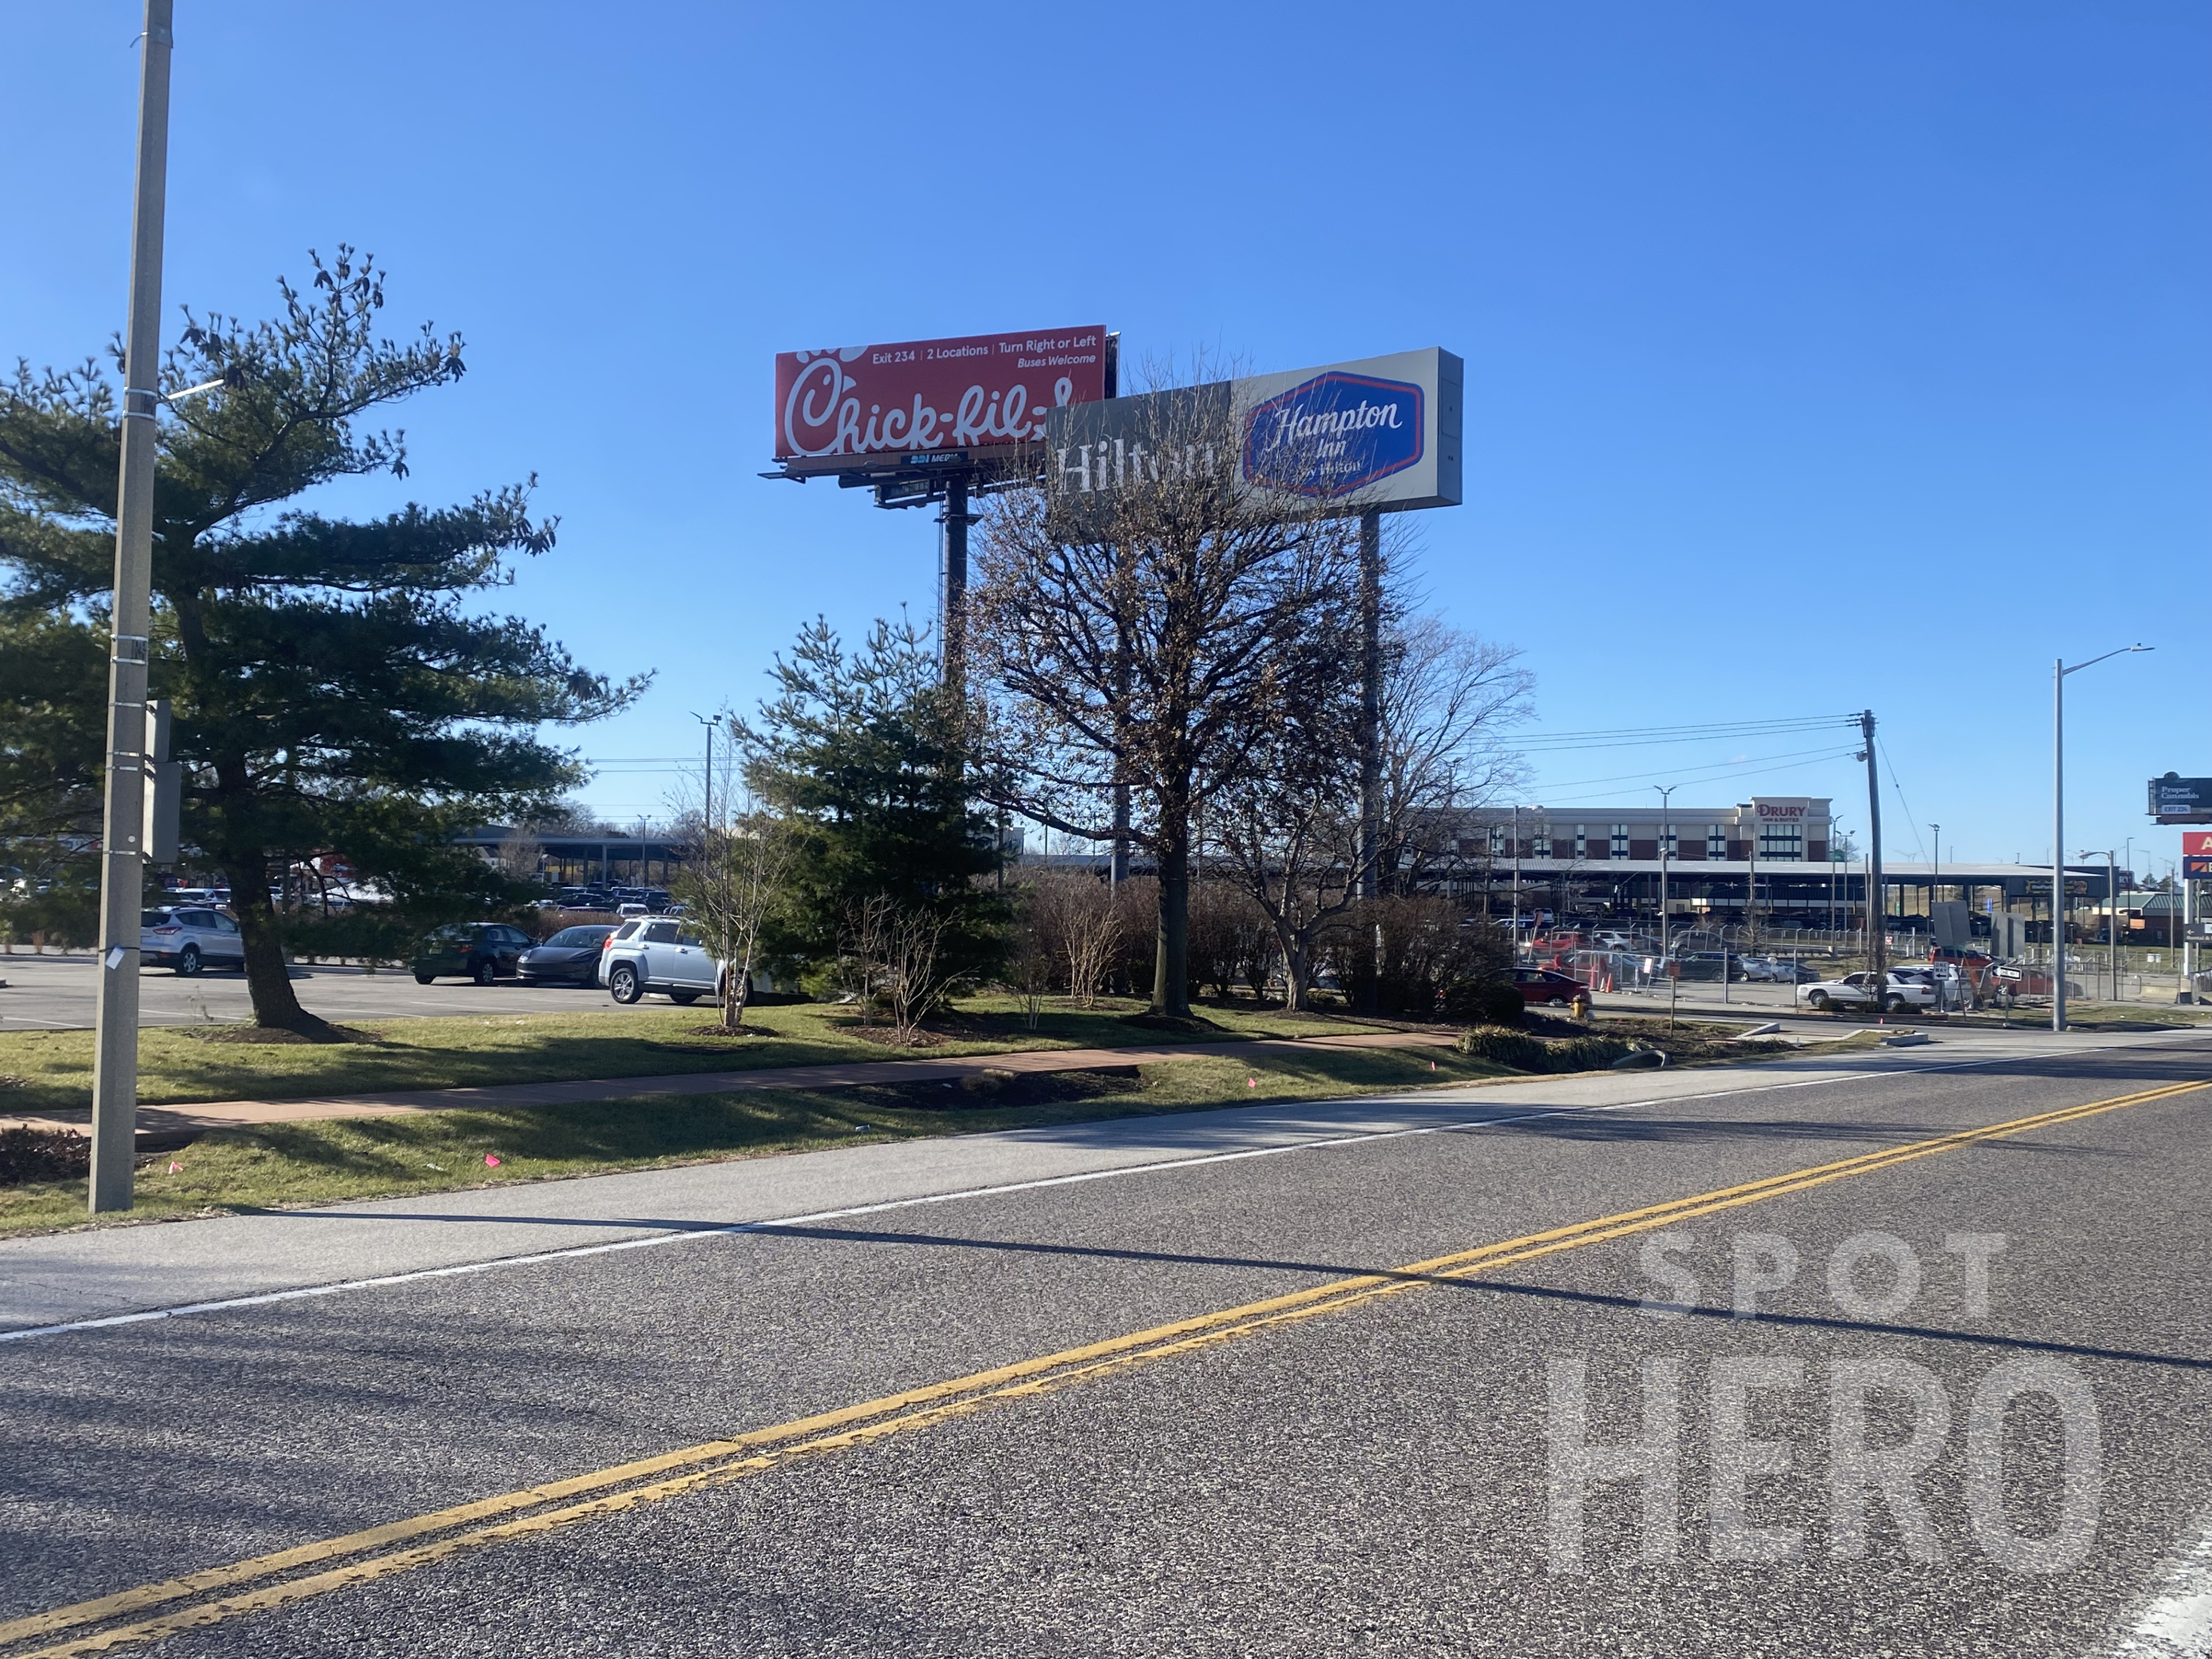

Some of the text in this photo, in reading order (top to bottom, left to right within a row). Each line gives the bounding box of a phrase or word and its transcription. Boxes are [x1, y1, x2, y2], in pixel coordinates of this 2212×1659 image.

[873, 335, 1097, 364] Exit 234 2 Locations Turn Right or Left
[1017, 355, 1096, 368] Buses Welcome
[1266, 399, 1403, 452] Hampton
[1757, 804, 1805, 816] DRURY
